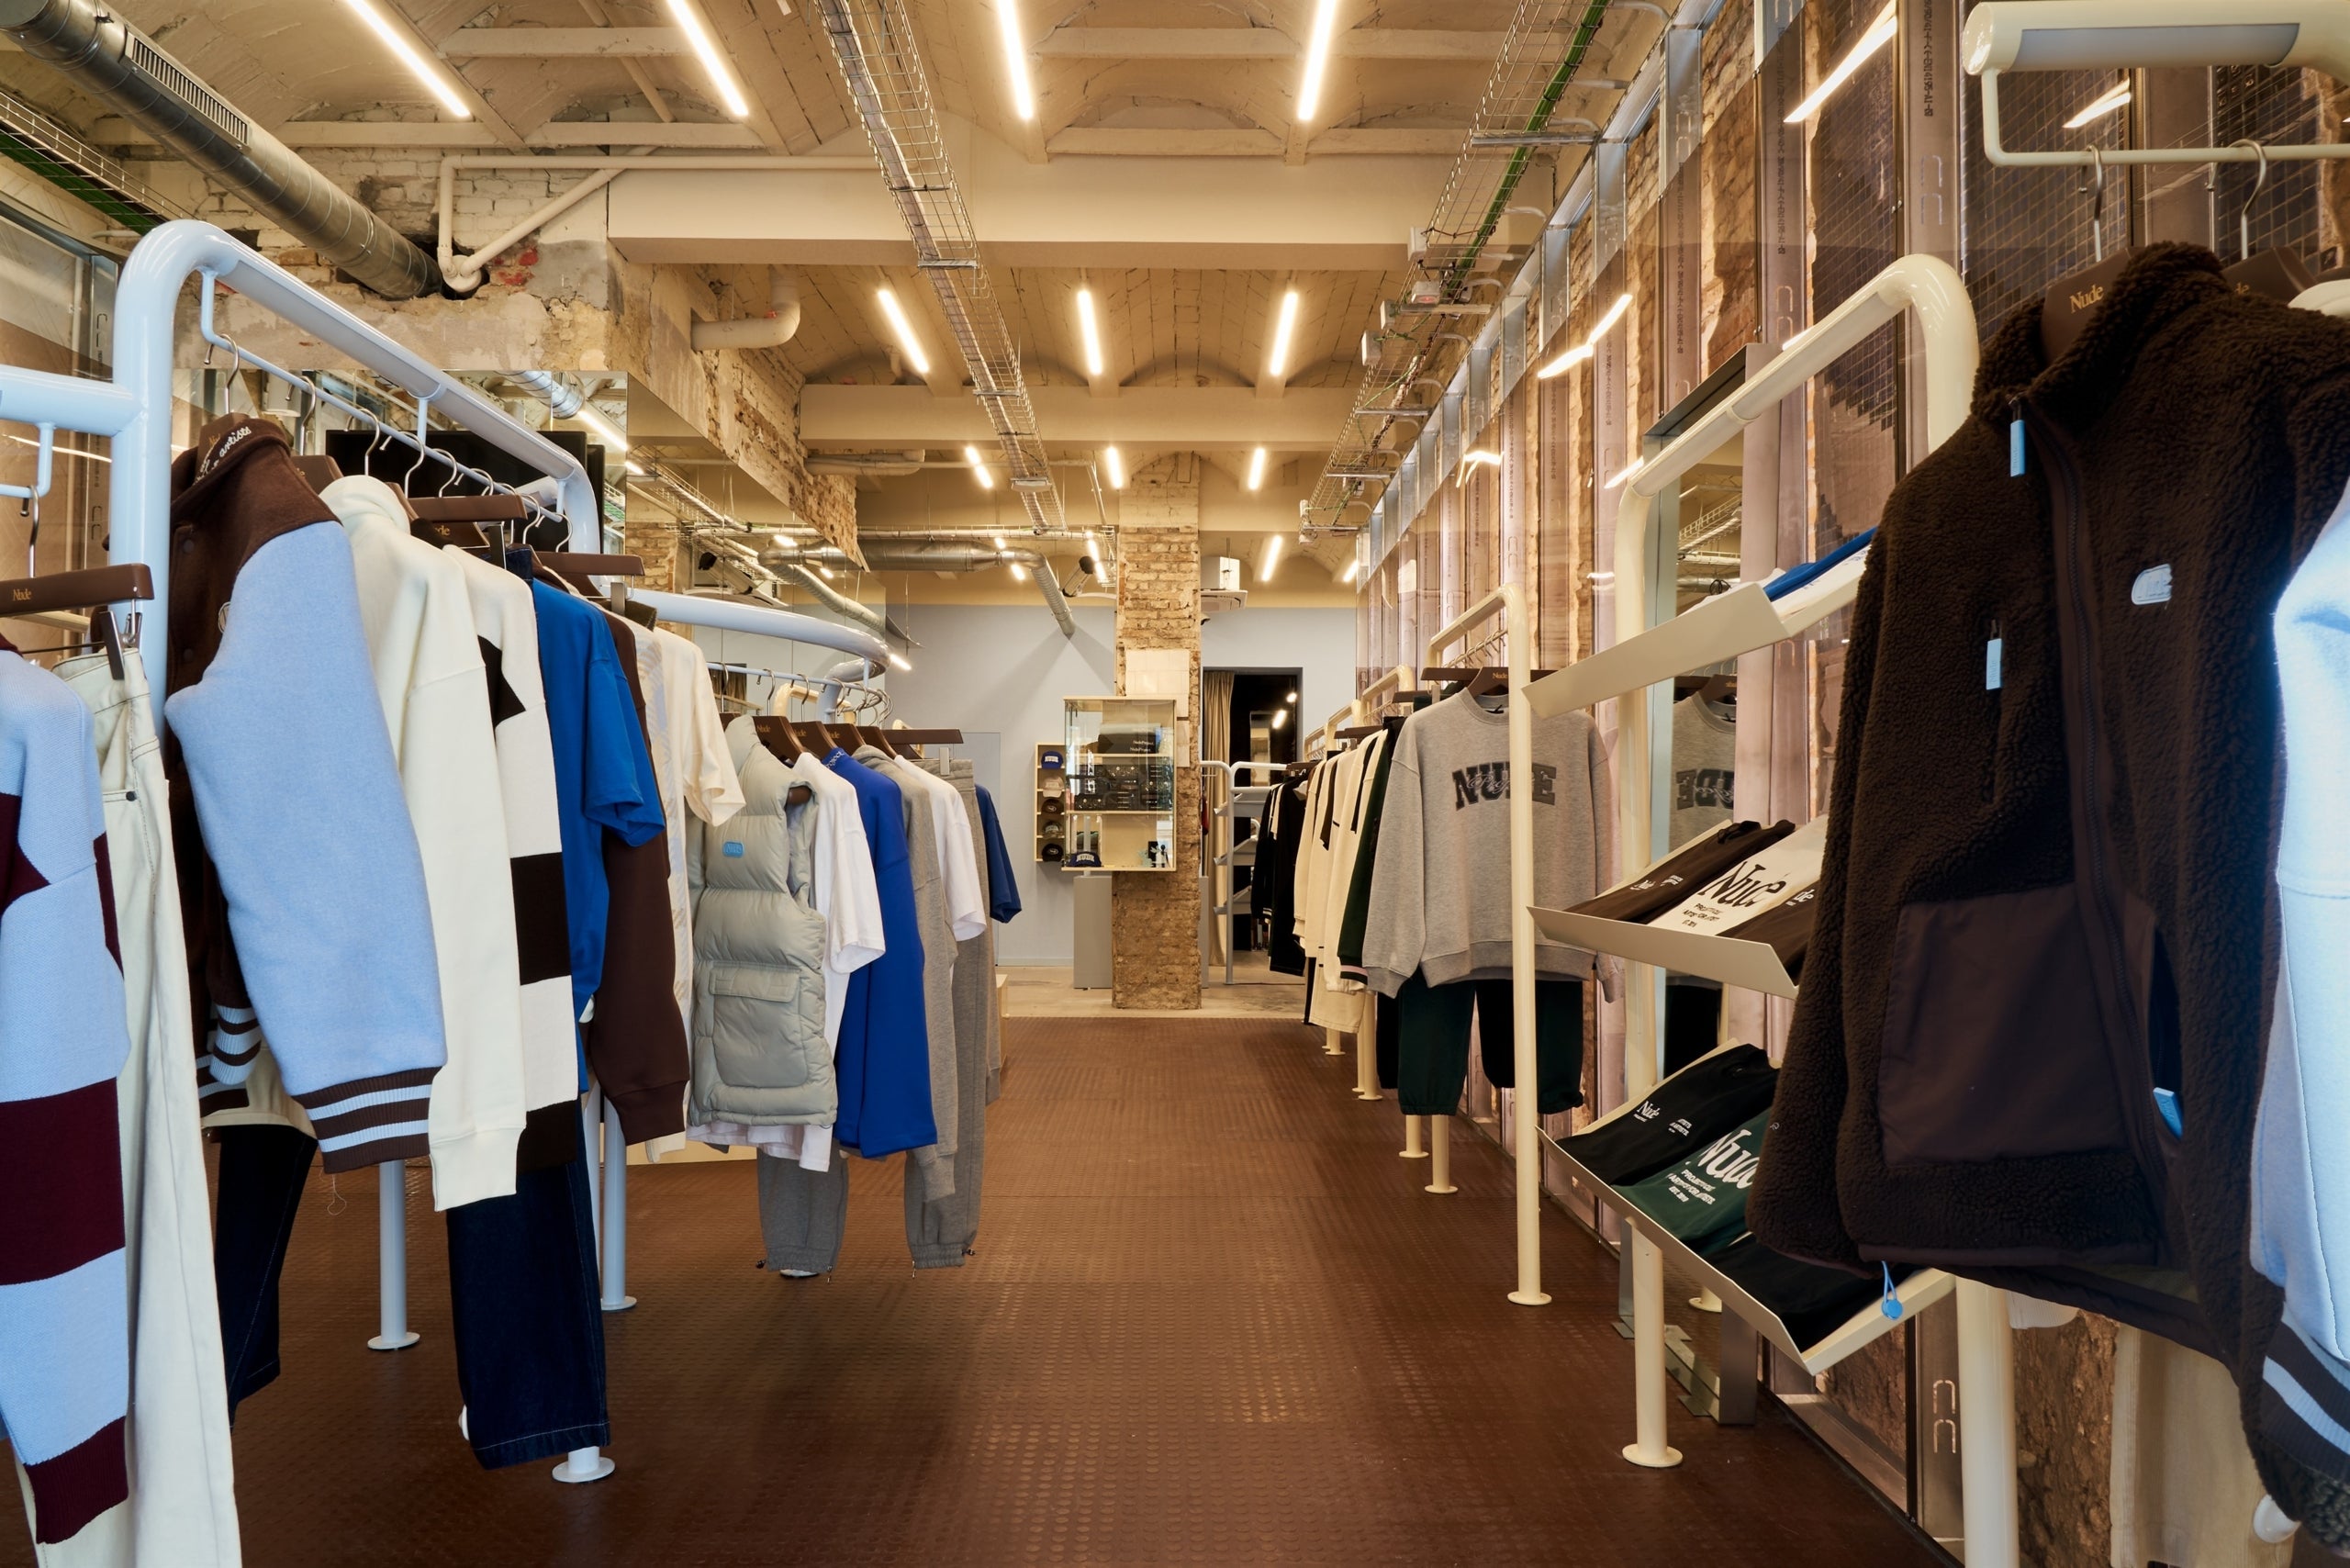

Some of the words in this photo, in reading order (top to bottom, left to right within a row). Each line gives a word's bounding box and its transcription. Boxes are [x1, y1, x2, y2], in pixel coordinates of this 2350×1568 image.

[2069, 284, 2104, 313] Nude
[219, 426, 252, 457] artists
[13, 588, 32, 601] Nude
[1451, 761, 1558, 812] NUE
